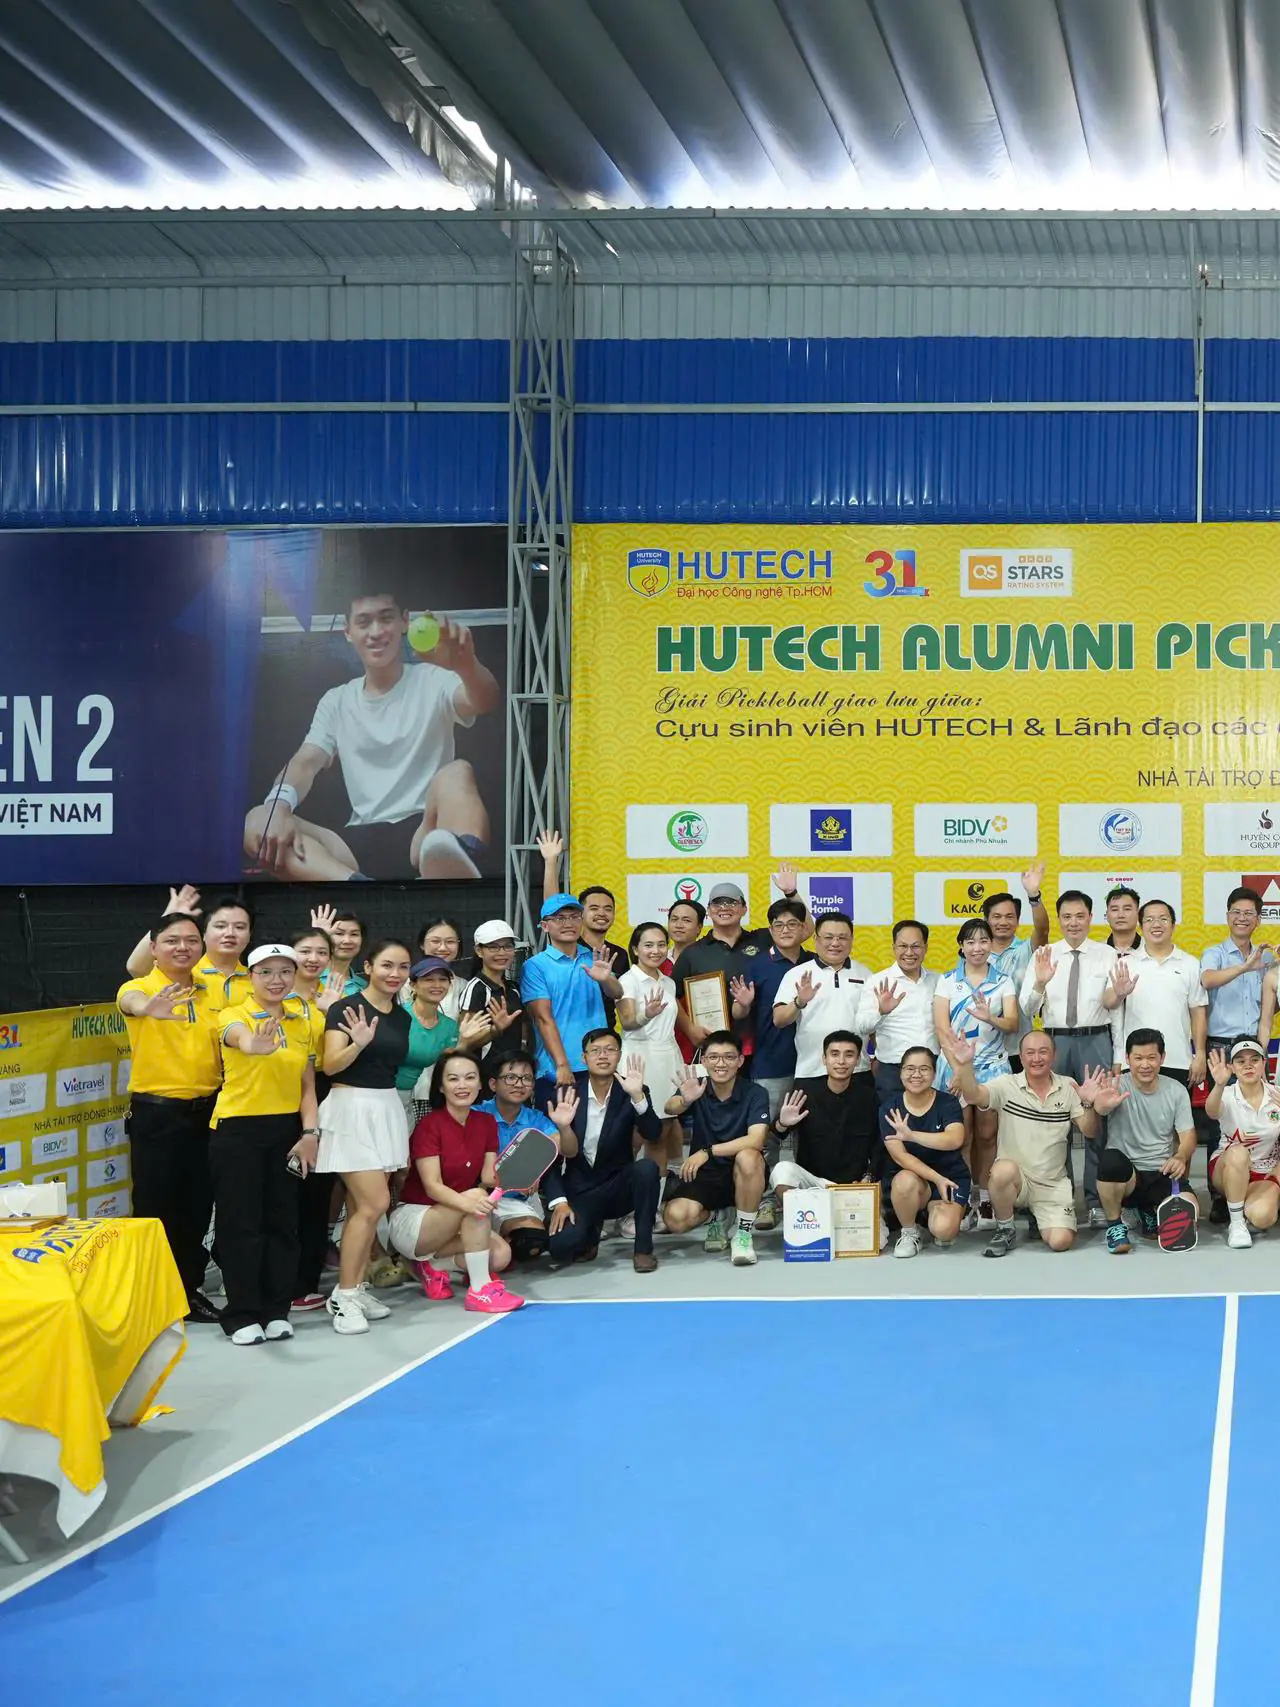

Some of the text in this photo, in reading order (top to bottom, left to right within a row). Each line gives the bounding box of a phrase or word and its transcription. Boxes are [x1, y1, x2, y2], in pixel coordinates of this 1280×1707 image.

[677, 550, 832, 580] HUTECH
[972, 564, 998, 584] QS
[1007, 565, 1064, 580] STARS
[677, 584, 832, 600] Đại học Công nghệ Tp.HCM
[656, 624, 882, 673] HUTECH
[902, 622, 1135, 672] ALUMNI
[654, 686, 708, 715] Giải
[717, 686, 828, 710] Pickleball
[828, 694, 878, 716] giao
[885, 690, 918, 709] lưu
[0, 694, 115, 782] N 2
[655, 719, 718, 742] Cựu
[729, 718, 793, 738] sinh
[803, 715, 865, 738] viên
[876, 718, 1014, 738] HUTECH
[1024, 718, 1047, 738] &
[1055, 716, 1131, 738] Lãnh
[1142, 716, 1201, 741] đạo
[1212, 715, 1268, 737] các
[1138, 766, 1180, 788] NHÀ
[1184, 766, 1216, 788] TÀI
[1221, 767, 1265, 790] TRỢ
[49, 803, 101, 823] NAM
[943, 819, 991, 836] BIDV
[1249, 841, 1280, 850] GROUP
[809, 895, 843, 909] Purple
[72, 1014, 106, 1039] HUTECH
[63, 1075, 104, 1093] Vietravel
[43, 1140, 62, 1153] BIDV
